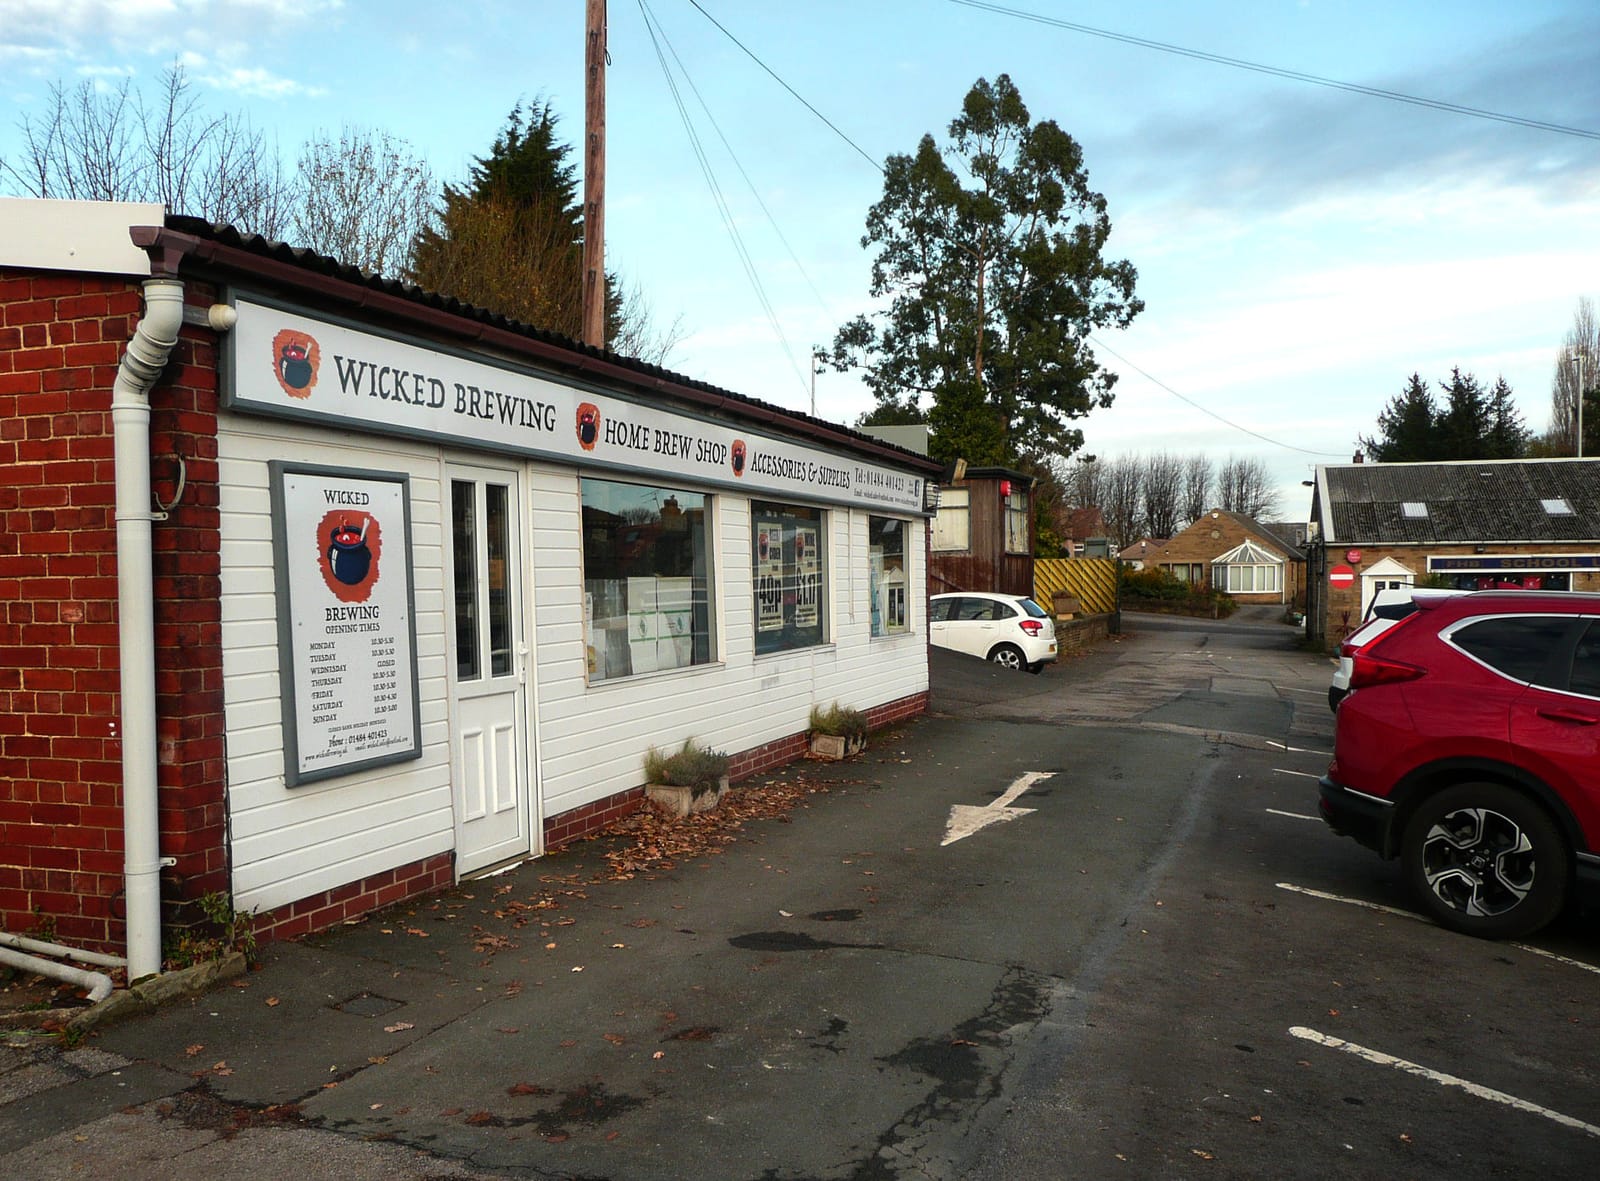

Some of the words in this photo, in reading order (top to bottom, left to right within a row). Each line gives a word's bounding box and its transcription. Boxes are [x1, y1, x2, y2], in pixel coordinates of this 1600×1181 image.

[333, 355, 445, 409] WICKED
[454, 383, 556, 432] BREWING
[605, 418, 649, 450] HOME
[654, 429, 693, 460] BREW
[696, 438, 728, 465] SHOP
[751, 451, 807, 482] ACCESSORIES
[808, 463, 818, 482] &
[819, 465, 850, 489] SUPPLIES
[885, 475, 904, 491] 401423
[324, 489, 370, 505] WICKED
[1501, 558, 1583, 568] SCHOOL
[759, 574, 781, 613] 40p
[325, 606, 380, 621] BREWING
[325, 624, 358, 634] OPENING
[360, 622, 380, 632] TIMES
[310, 642, 335, 650] MONDAY
[310, 653, 336, 663] TUESDAY
[310, 664, 347, 675] WEDNESDAY
[311, 677, 342, 687] THURSDAY
[312, 690, 333, 699] FRIDAY
[312, 701, 343, 712] SATURDAY
[312, 714, 337, 724] SUNDAY
[328, 735, 344, 747] Phone
[348, 733, 366, 744] 01484
[367, 730, 387, 740] 401423
